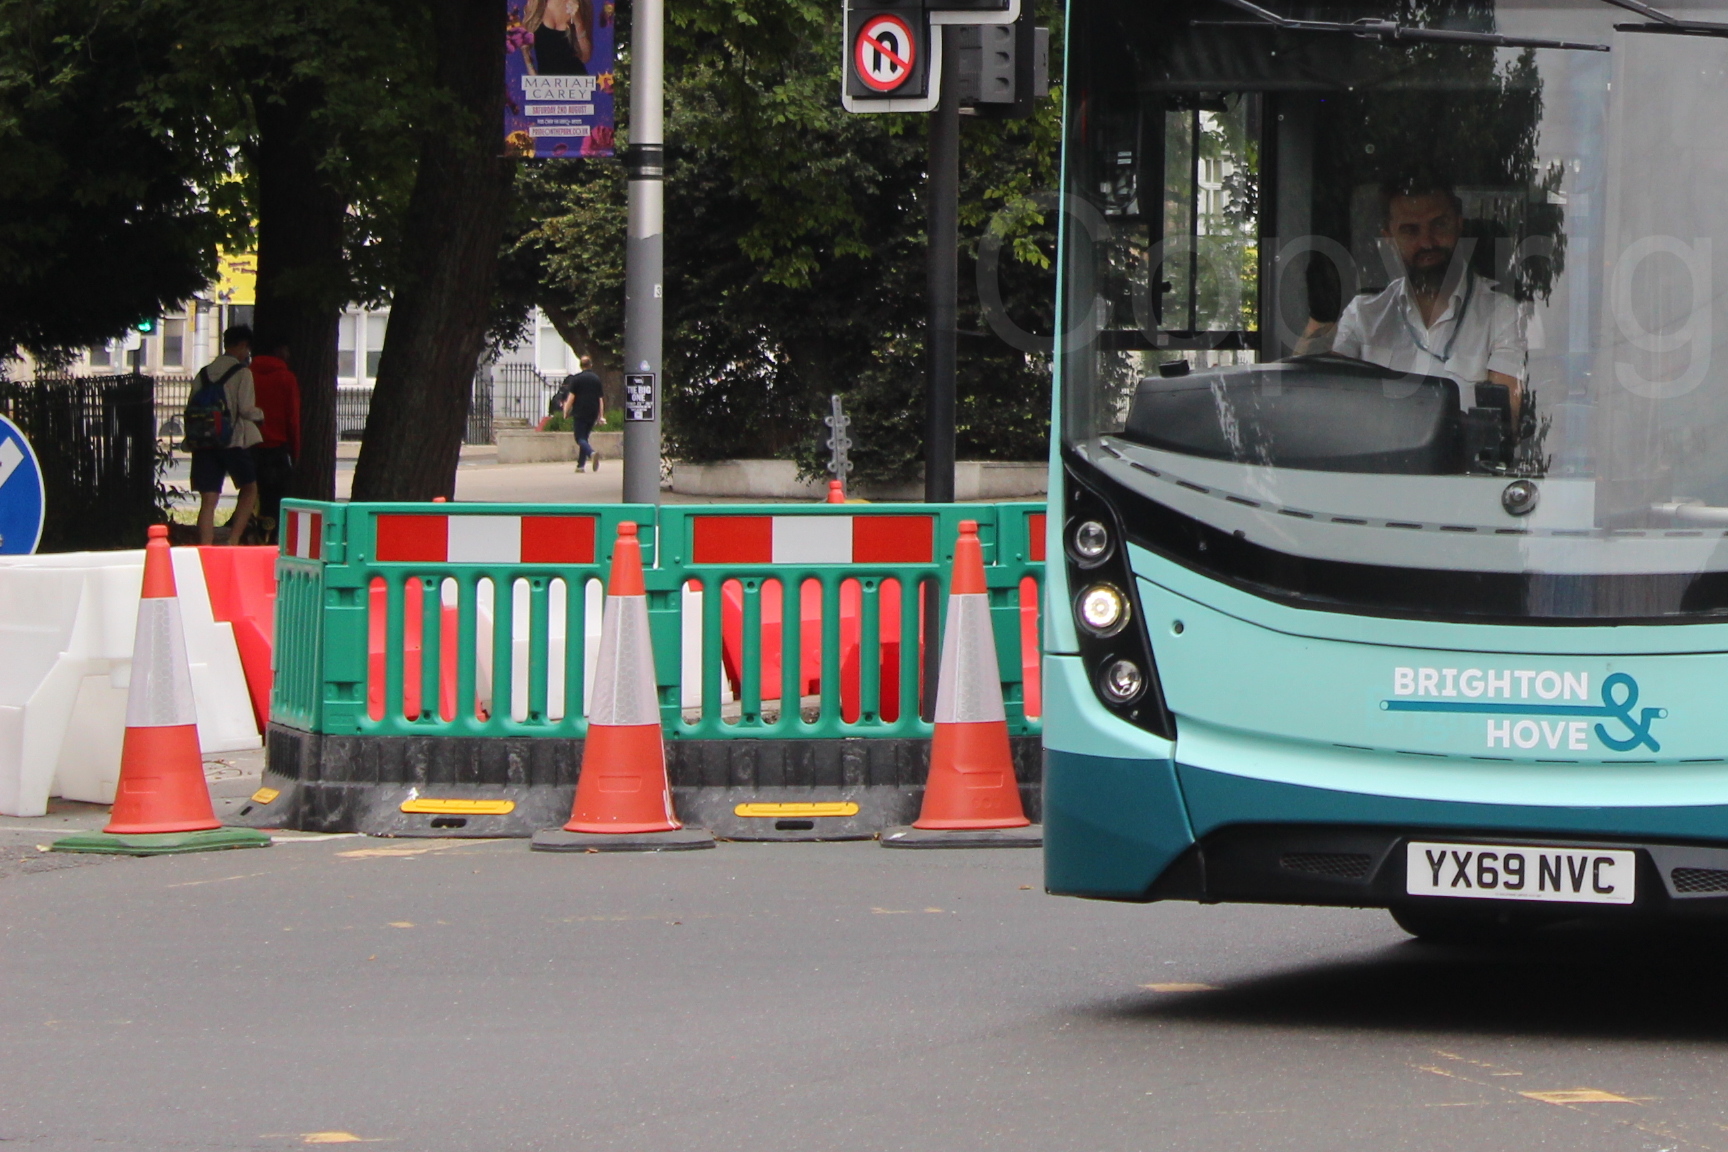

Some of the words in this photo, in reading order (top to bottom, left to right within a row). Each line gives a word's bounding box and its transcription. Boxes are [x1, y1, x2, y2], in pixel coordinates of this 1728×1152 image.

[524, 77, 595, 88] MARIAH
[532, 89, 587, 99] CAREY
[1393, 666, 1589, 701] BRIGHTON
[1486, 719, 1589, 750] HOVE
[1425, 849, 1526, 890] YX69
[1538, 853, 1616, 894] NVC
